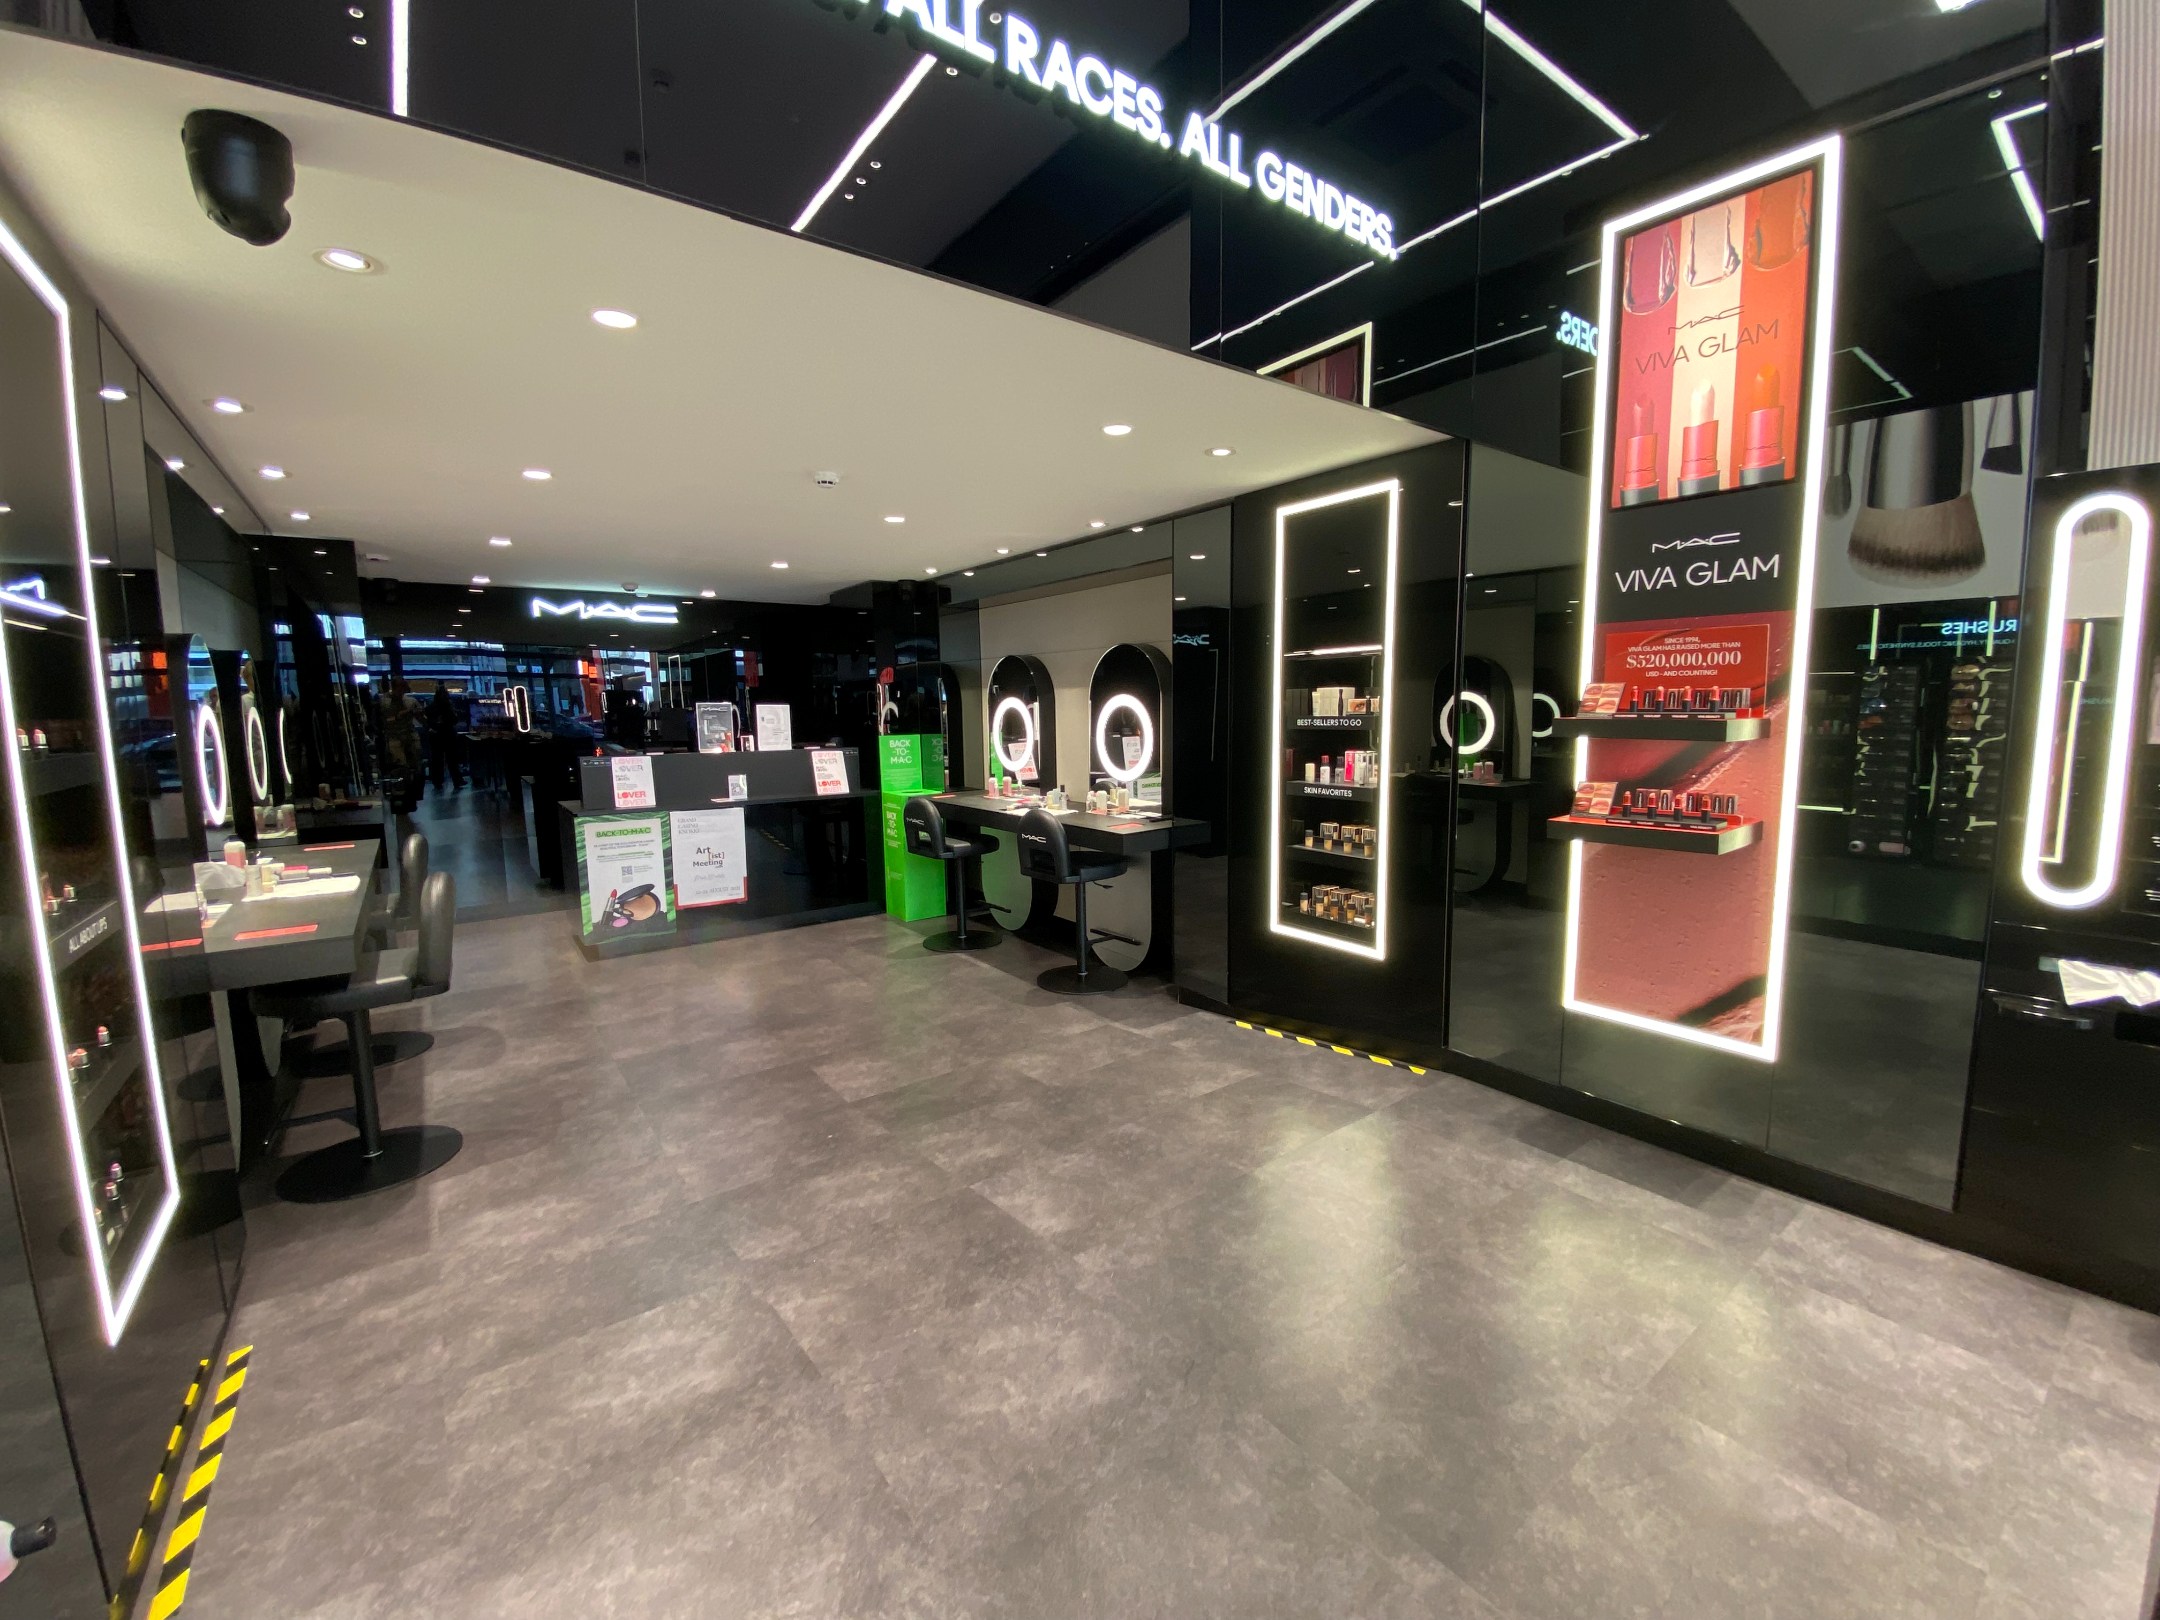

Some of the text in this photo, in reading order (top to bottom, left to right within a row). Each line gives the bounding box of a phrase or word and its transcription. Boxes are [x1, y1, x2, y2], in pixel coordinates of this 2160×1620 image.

[1006, 14, 1172, 150] RACES.
[1179, 112, 1251, 188] ALL
[1256, 151, 1399, 262] GENDERS.
[1635, 318, 1780, 375] VIVA GLAM
[1614, 554, 1780, 593] VIVA GLAM
[1676, 643, 1700, 651] RAISED
[1625, 650, 1742, 668] $520,000,000
[1678, 669, 1718, 677] COUNTING!
[1296, 718, 1362, 727] BEST-SELLERS TO GO
[889, 739, 911, 748] BACK
[892, 747, 910, 756] -TO-
[617, 791, 647, 799] LOVER
[1303, 786, 1353, 798] SKIN FAVORITES
[693, 860, 723, 868] Meeting
